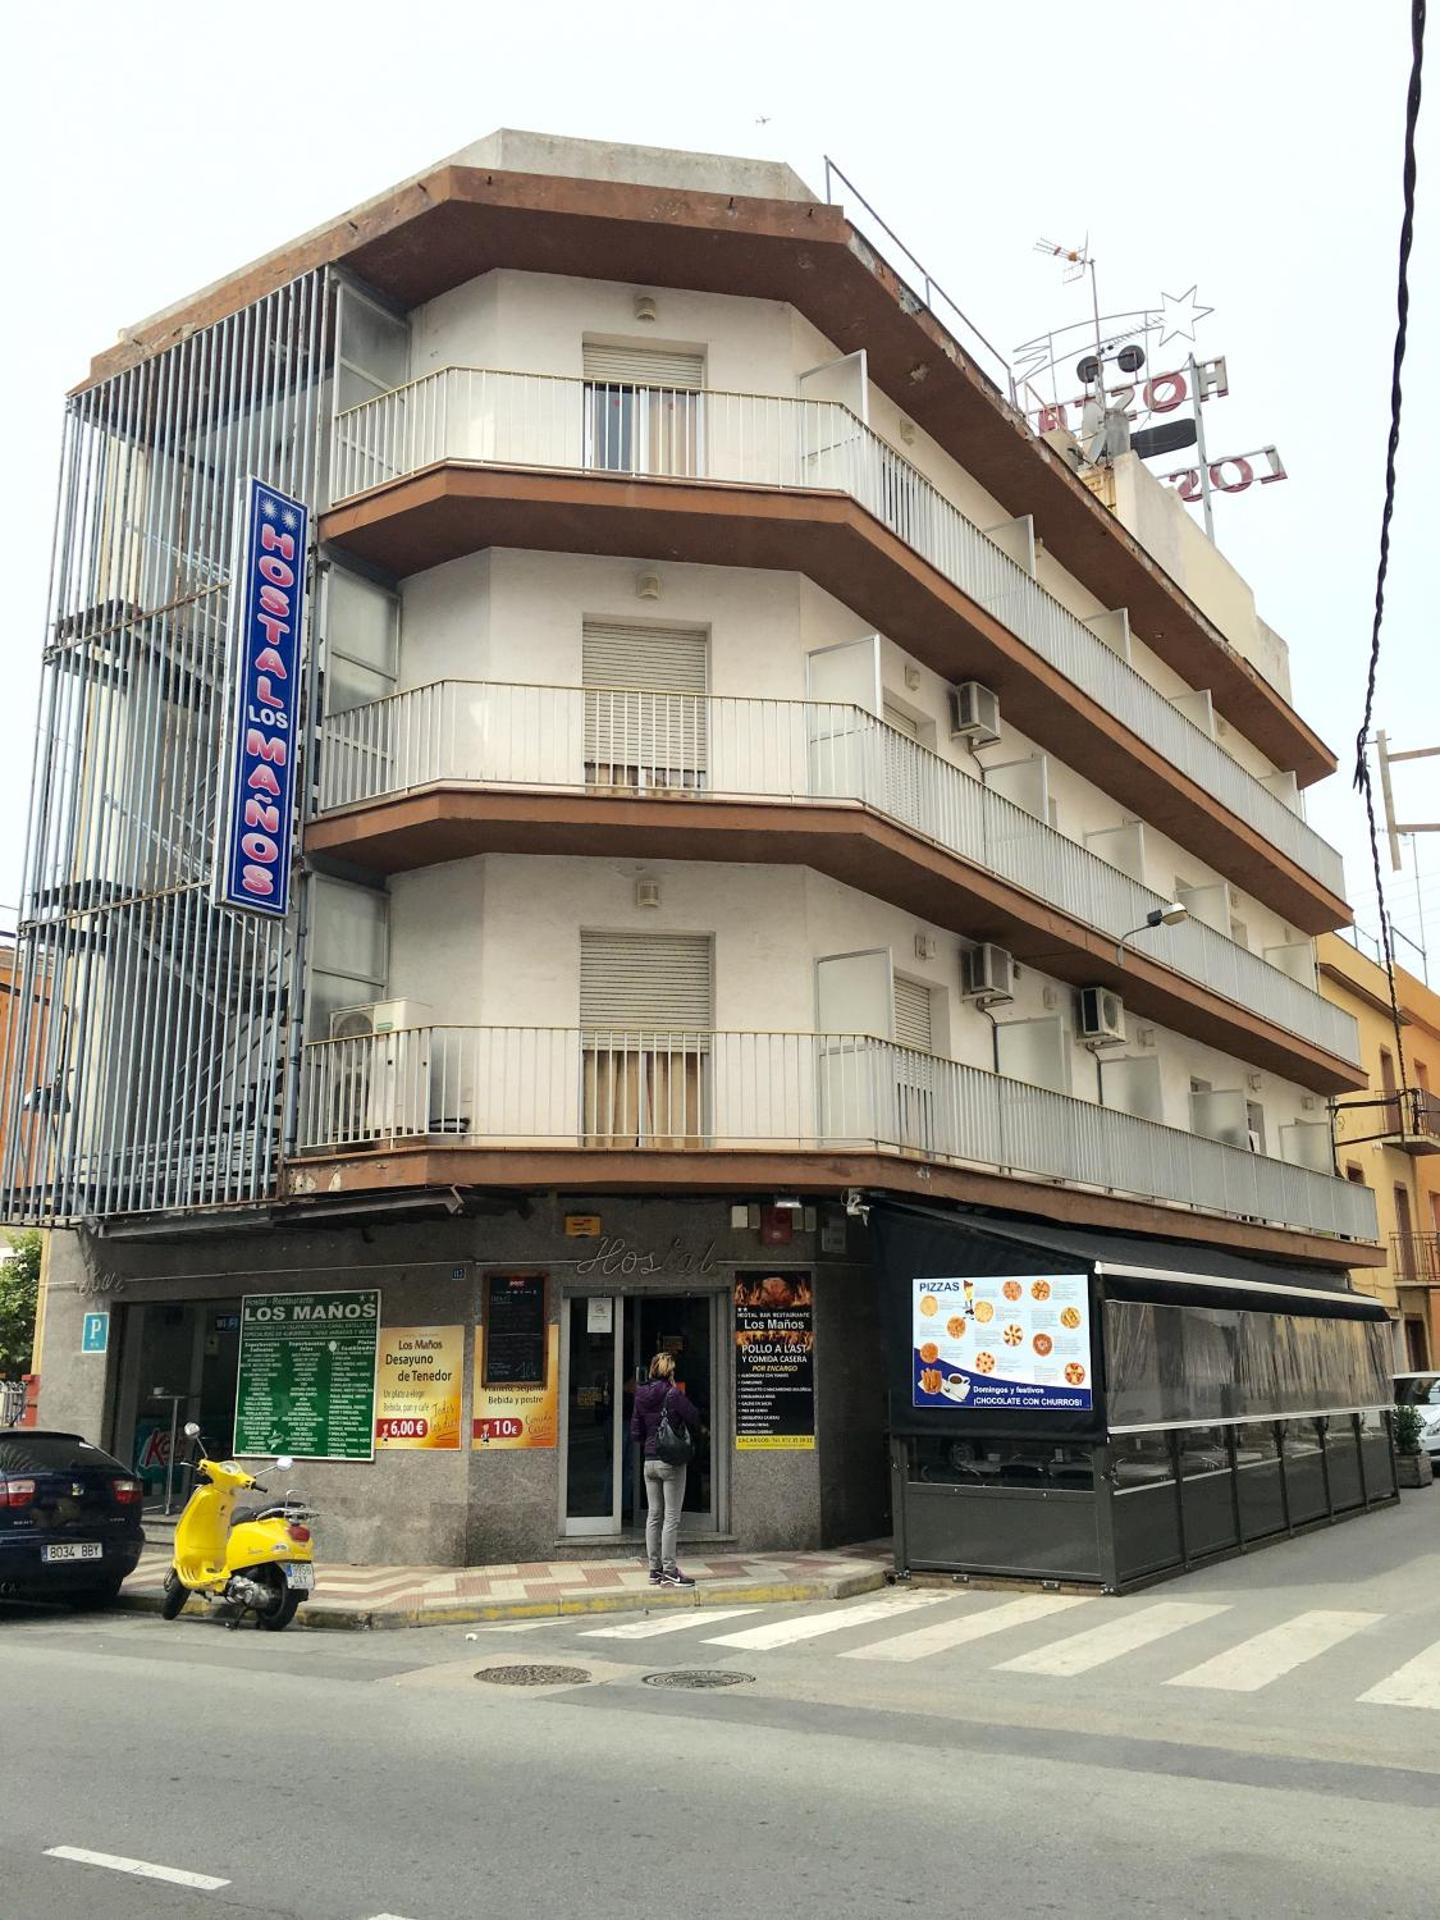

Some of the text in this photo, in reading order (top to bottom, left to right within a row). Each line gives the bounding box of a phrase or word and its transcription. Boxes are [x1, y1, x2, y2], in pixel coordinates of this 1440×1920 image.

[241, 523, 295, 896] HOSTAL LOS MAÑOS
[919, 1282, 960, 1292] PIZZAS
[244, 1301, 376, 1321] LOS MAÑOS
[90, 1319, 102, 1340] P
[744, 1319, 805, 1330] Los Maños
[398, 1339, 443, 1351] Los Maños
[742, 1344, 773, 1354] POLLO
[774, 1344, 782, 1354] A
[385, 1354, 434, 1368] Desayuno
[742, 1355, 807, 1363] Y COMIDA CASERA
[398, 1368, 453, 1382] de Tenedor
[973, 1385, 1008, 1395] Domingos
[1016, 1385, 1045, 1394] festivos
[489, 1396, 513, 1404] Bebida
[520, 1395, 544, 1405] postre
[1022, 1397, 1039, 1405] CON
[391, 1420, 425, 1437] 6,00 €
[50, 1546, 75, 1558] 8034
